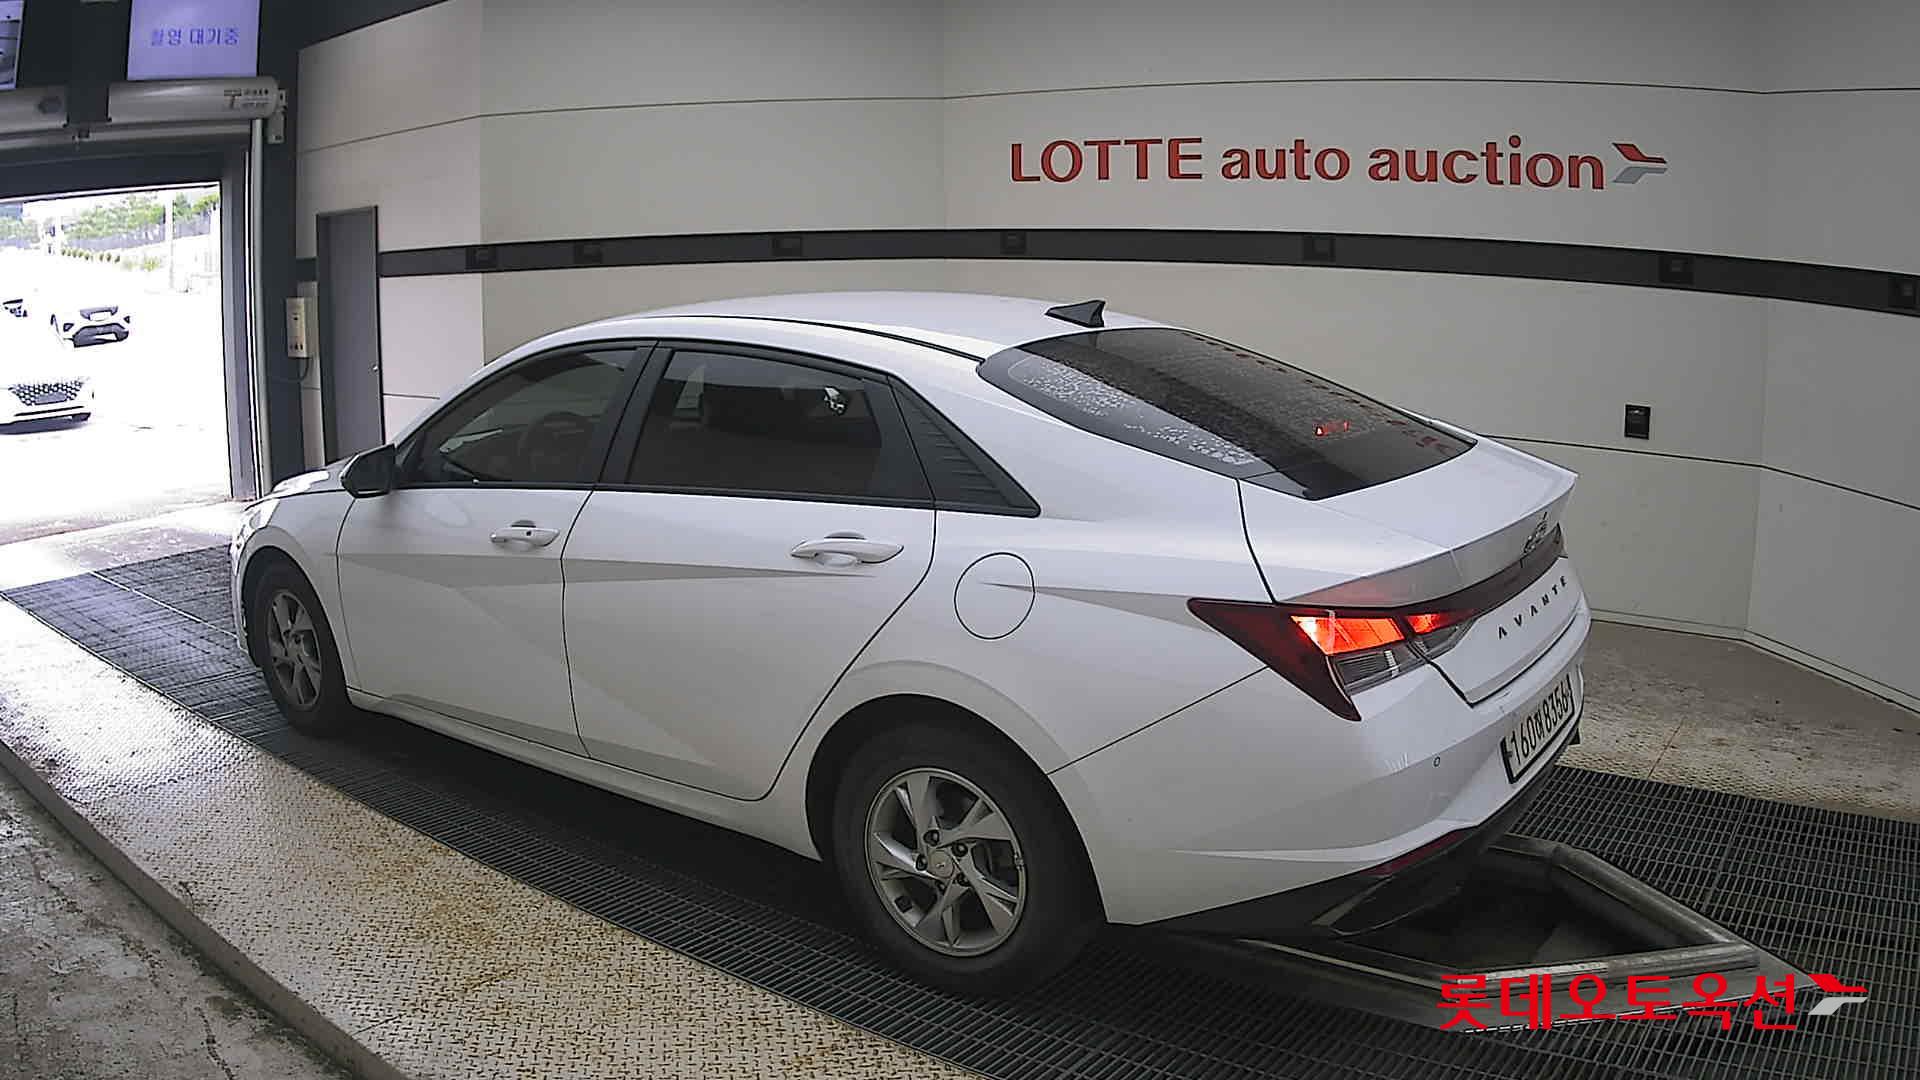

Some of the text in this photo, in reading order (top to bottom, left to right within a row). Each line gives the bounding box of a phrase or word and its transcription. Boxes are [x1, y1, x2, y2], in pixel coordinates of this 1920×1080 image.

[189, 27, 240, 46] 대기중
[1010, 135, 1605, 190] LOTTE auto auction
[1497, 575, 1567, 640] AVANTE
